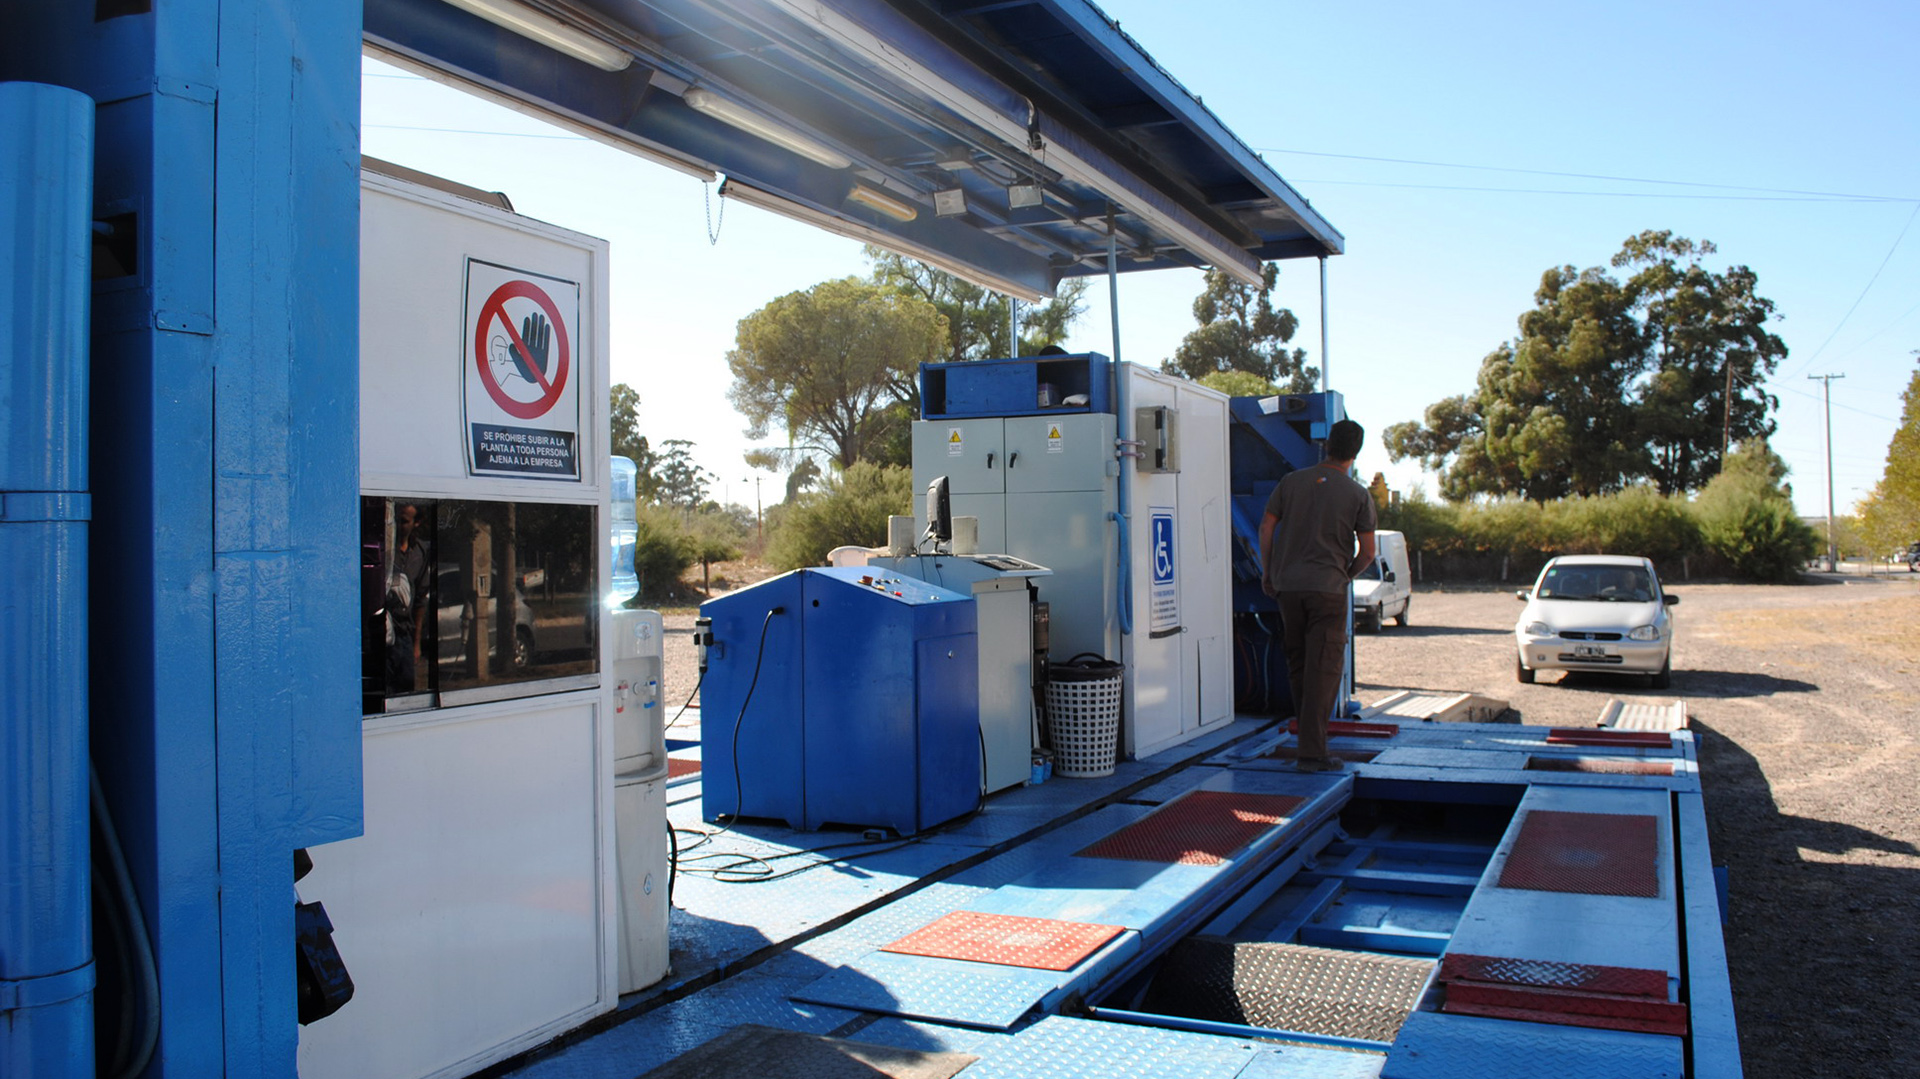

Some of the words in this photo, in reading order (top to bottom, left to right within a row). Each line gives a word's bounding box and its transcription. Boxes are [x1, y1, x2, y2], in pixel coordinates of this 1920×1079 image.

[484, 431, 493, 440] SE
[495, 432, 526, 443] PROHIBE
[528, 435, 548, 444] SUBIR
[556, 438, 565, 446] LA
[481, 443, 509, 452] PLANTA
[516, 446, 536, 455] TODA
[537, 448, 569, 457] PERSONA
[489, 455, 513, 464] AJENA
[520, 457, 530, 465] LA
[531, 459, 563, 467] EMPRESA
